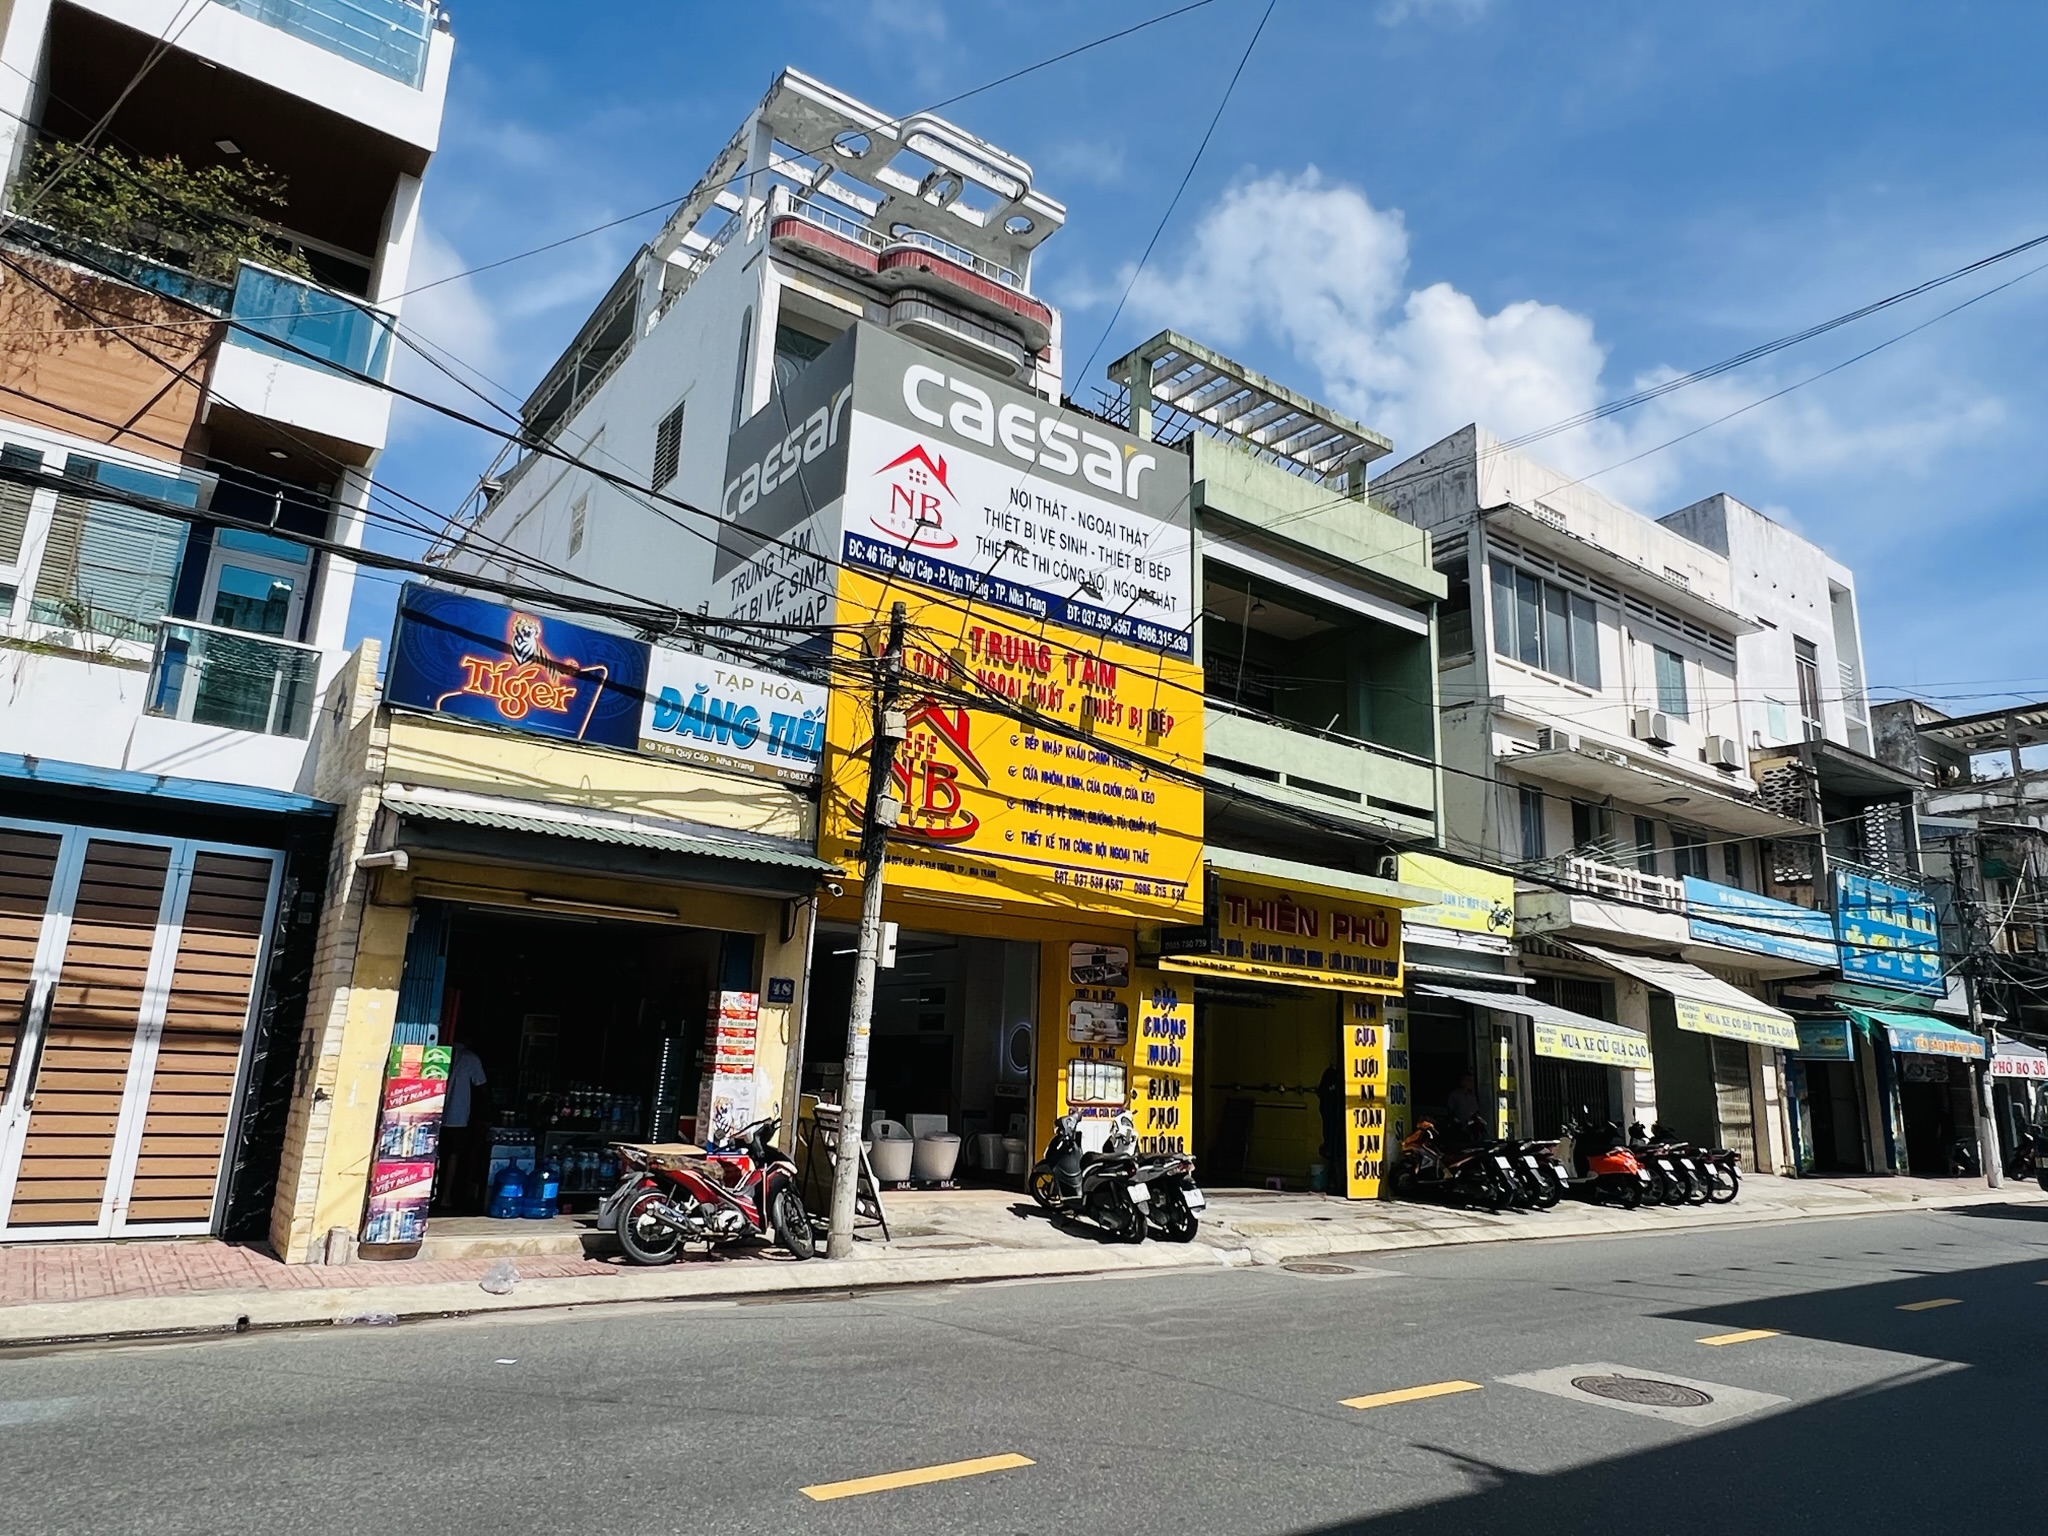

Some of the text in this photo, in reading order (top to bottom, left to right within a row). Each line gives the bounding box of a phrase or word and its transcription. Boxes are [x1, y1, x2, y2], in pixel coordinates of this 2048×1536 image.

[890, 483, 942, 527] NB
[891, 518, 938, 540] HOSE
[1060, 533, 1088, 557] SINH
[1032, 553, 1050, 575] THI
[732, 553, 775, 601] TRUNG
[789, 555, 828, 599] SINH
[866, 544, 878, 564] 46
[948, 568, 964, 592] Vạn
[1009, 587, 1024, 606] Nha
[1025, 592, 1046, 616] Trang
[972, 625, 1117, 690] TRUNG TÂM
[462, 655, 577, 720] Tiger
[714, 670, 804, 704] TẠP HÓA
[652, 683, 761, 750] ĐĂNG
[645, 742, 656, 751] 48
[716, 756, 732, 766] Nha
[733, 760, 754, 772] Trang
[1058, 837, 1070, 852] THI
[1225, 894, 1319, 938] THIÊN
[771, 982, 792, 996] 48
[1561, 1034, 1581, 1050] MUA
[1583, 1036, 1595, 1051] XE
[1597, 1036, 1610, 1053] CŨ
[1629, 1044, 1646, 1058] CAO
[2033, 1060, 2046, 1076] 36
[410, 1089, 431, 1100] NAM
[1361, 1084, 1374, 1100] AN
[1358, 1135, 1380, 1154] BAN
[396, 1173, 418, 1186] NAM
